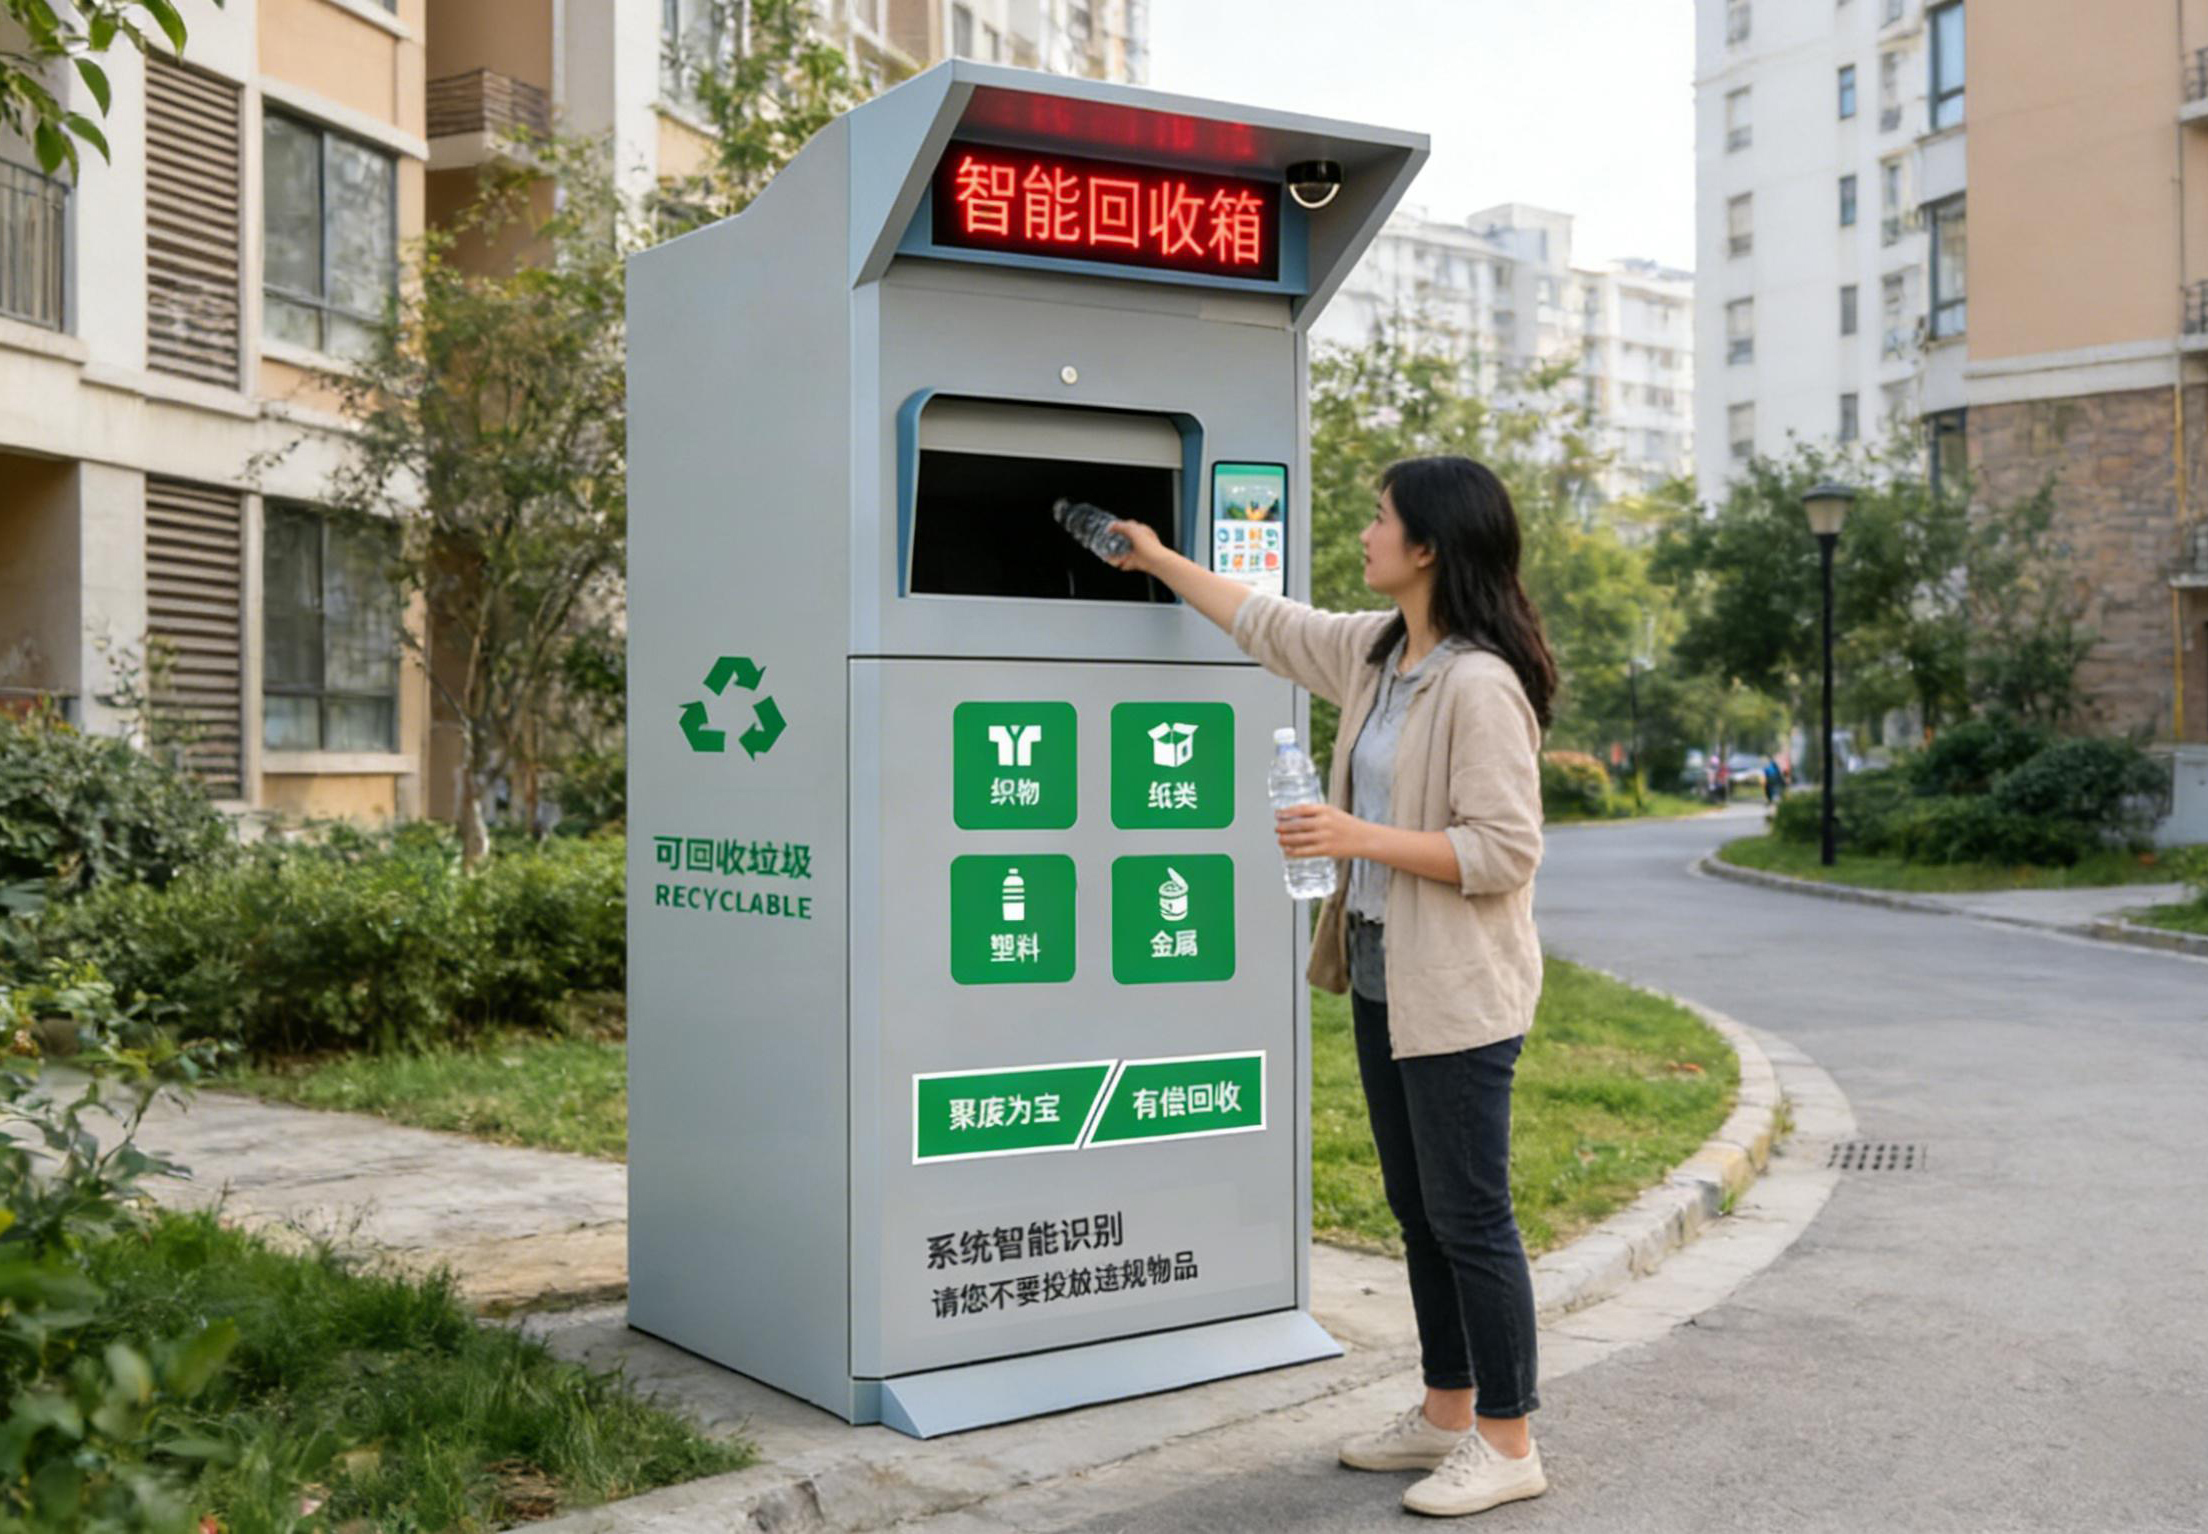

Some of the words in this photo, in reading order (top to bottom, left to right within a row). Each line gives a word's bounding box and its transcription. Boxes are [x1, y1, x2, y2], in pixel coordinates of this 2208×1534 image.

[956, 155, 1263, 265] 智能回收箱
[989, 777, 1040, 806] 织物
[1148, 781, 1198, 809] 纸类
[653, 835, 812, 879] 可回收垃圾
[655, 884, 812, 920] RECYCLABLE
[990, 932, 1041, 963] 塑料
[1132, 1081, 1242, 1121] 有偿回收
[926, 1210, 1124, 1270] 系统智能识别
[931, 1250, 1199, 1319] 请您不要投放违规物品
